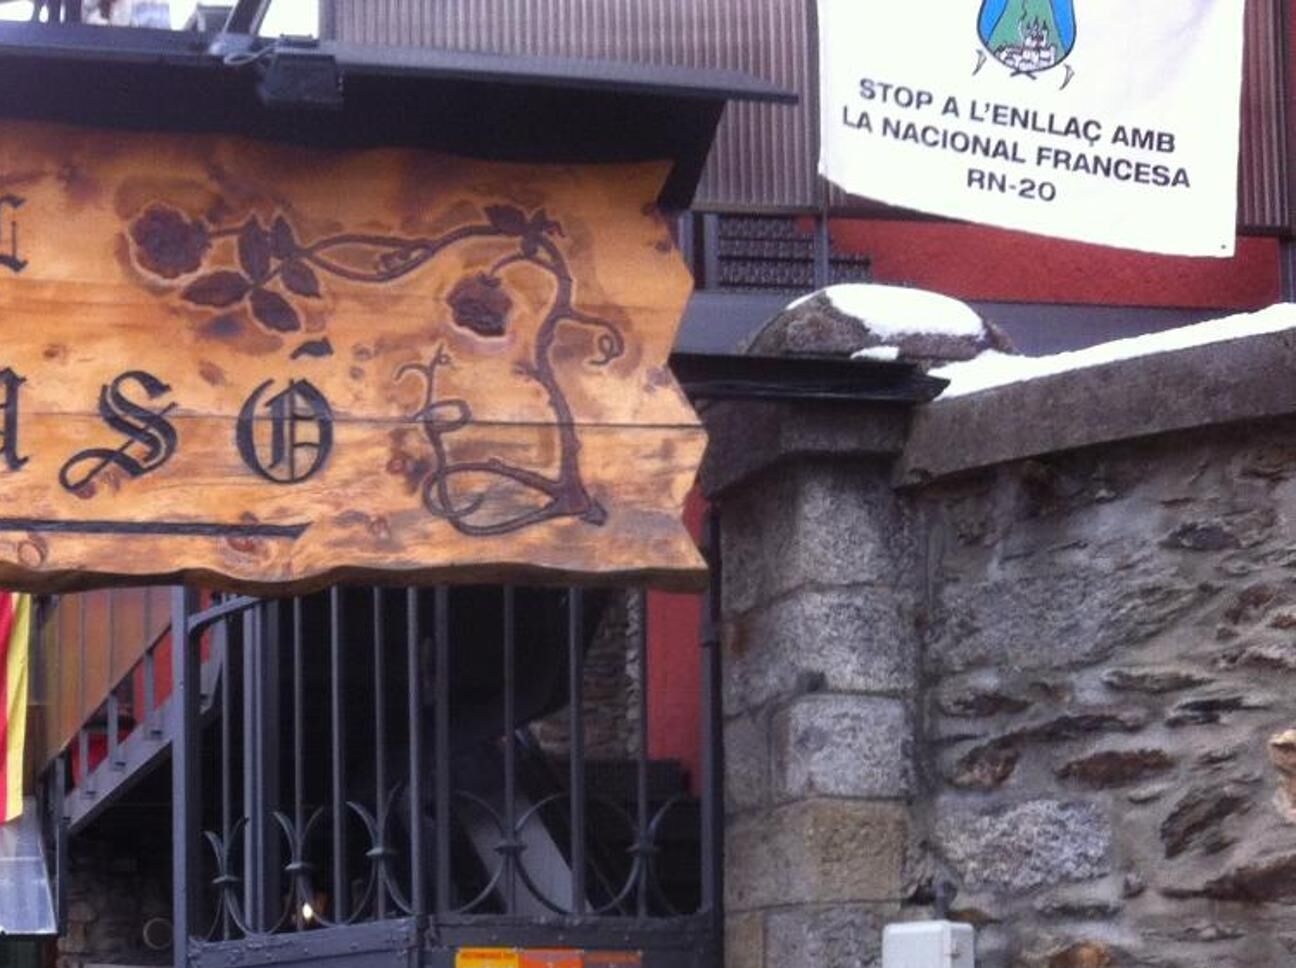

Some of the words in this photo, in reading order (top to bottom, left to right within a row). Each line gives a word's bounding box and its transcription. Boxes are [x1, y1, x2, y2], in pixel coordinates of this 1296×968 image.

[842, 105, 873, 133] LA
[882, 117, 1026, 163] NACIONAL
[1036, 147, 1191, 188] FRANCESA
[859, 78, 933, 111] STOP
[941, 97, 960, 118] A
[970, 101, 1102, 143] L'ENLLAÇ
[1111, 125, 1175, 153] AMB
[966, 169, 1056, 201] RN-20
